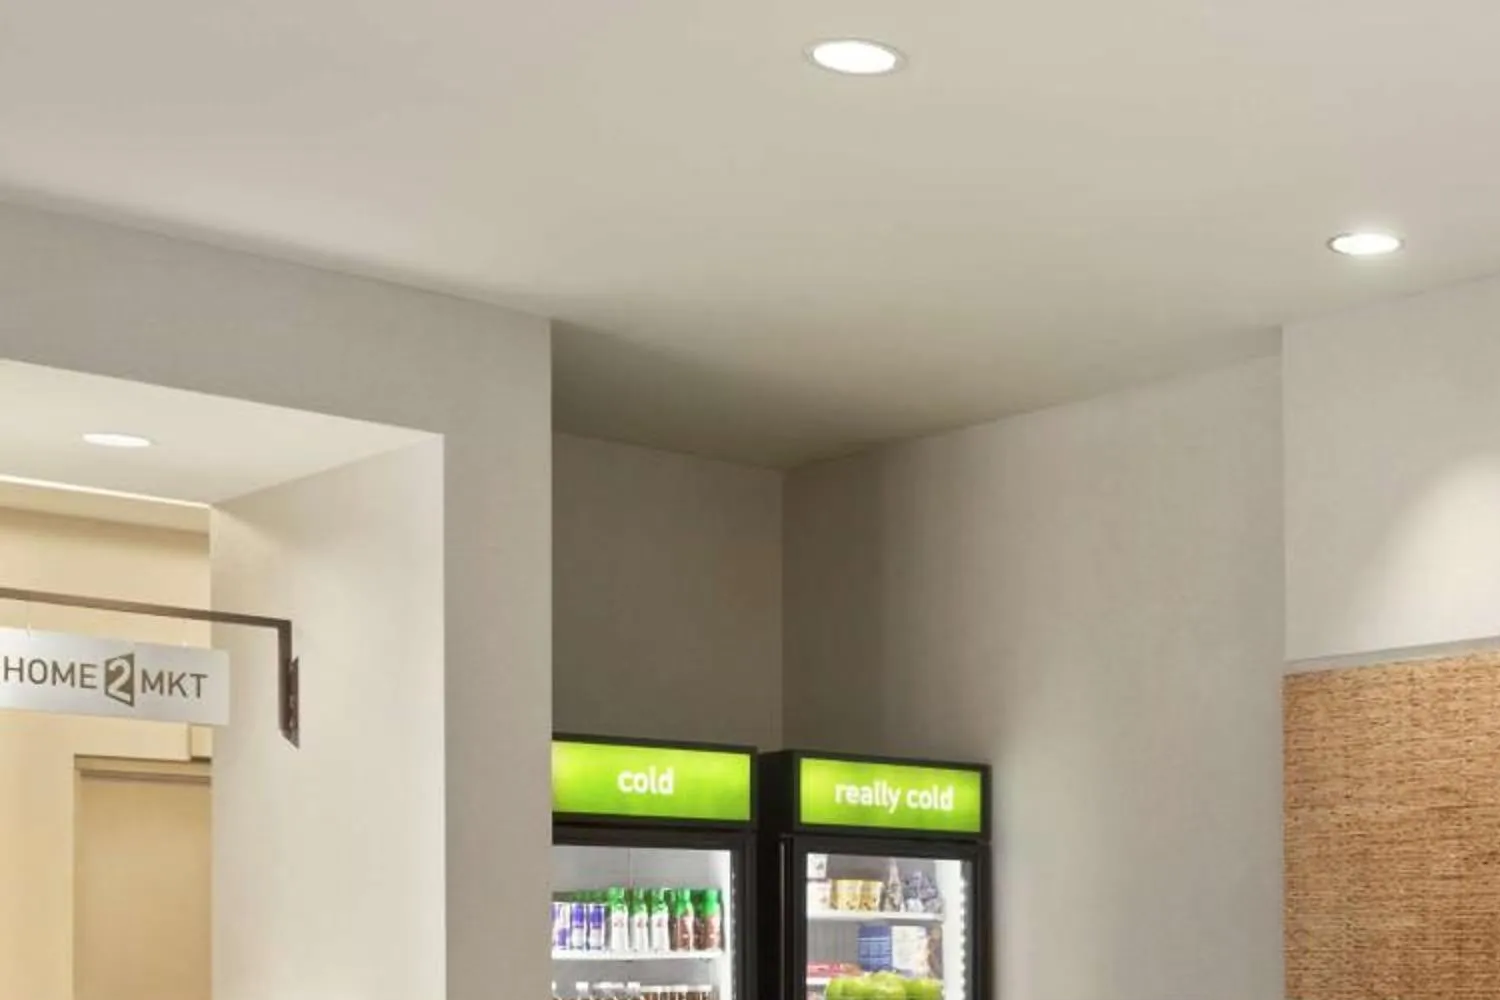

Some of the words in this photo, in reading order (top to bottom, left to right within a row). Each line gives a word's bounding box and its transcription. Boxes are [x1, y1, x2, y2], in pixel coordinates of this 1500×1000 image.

[141, 667, 209, 699] MKT
[617, 766, 674, 795] cold
[834, 780, 901, 814] really
[905, 785, 955, 811] cold
